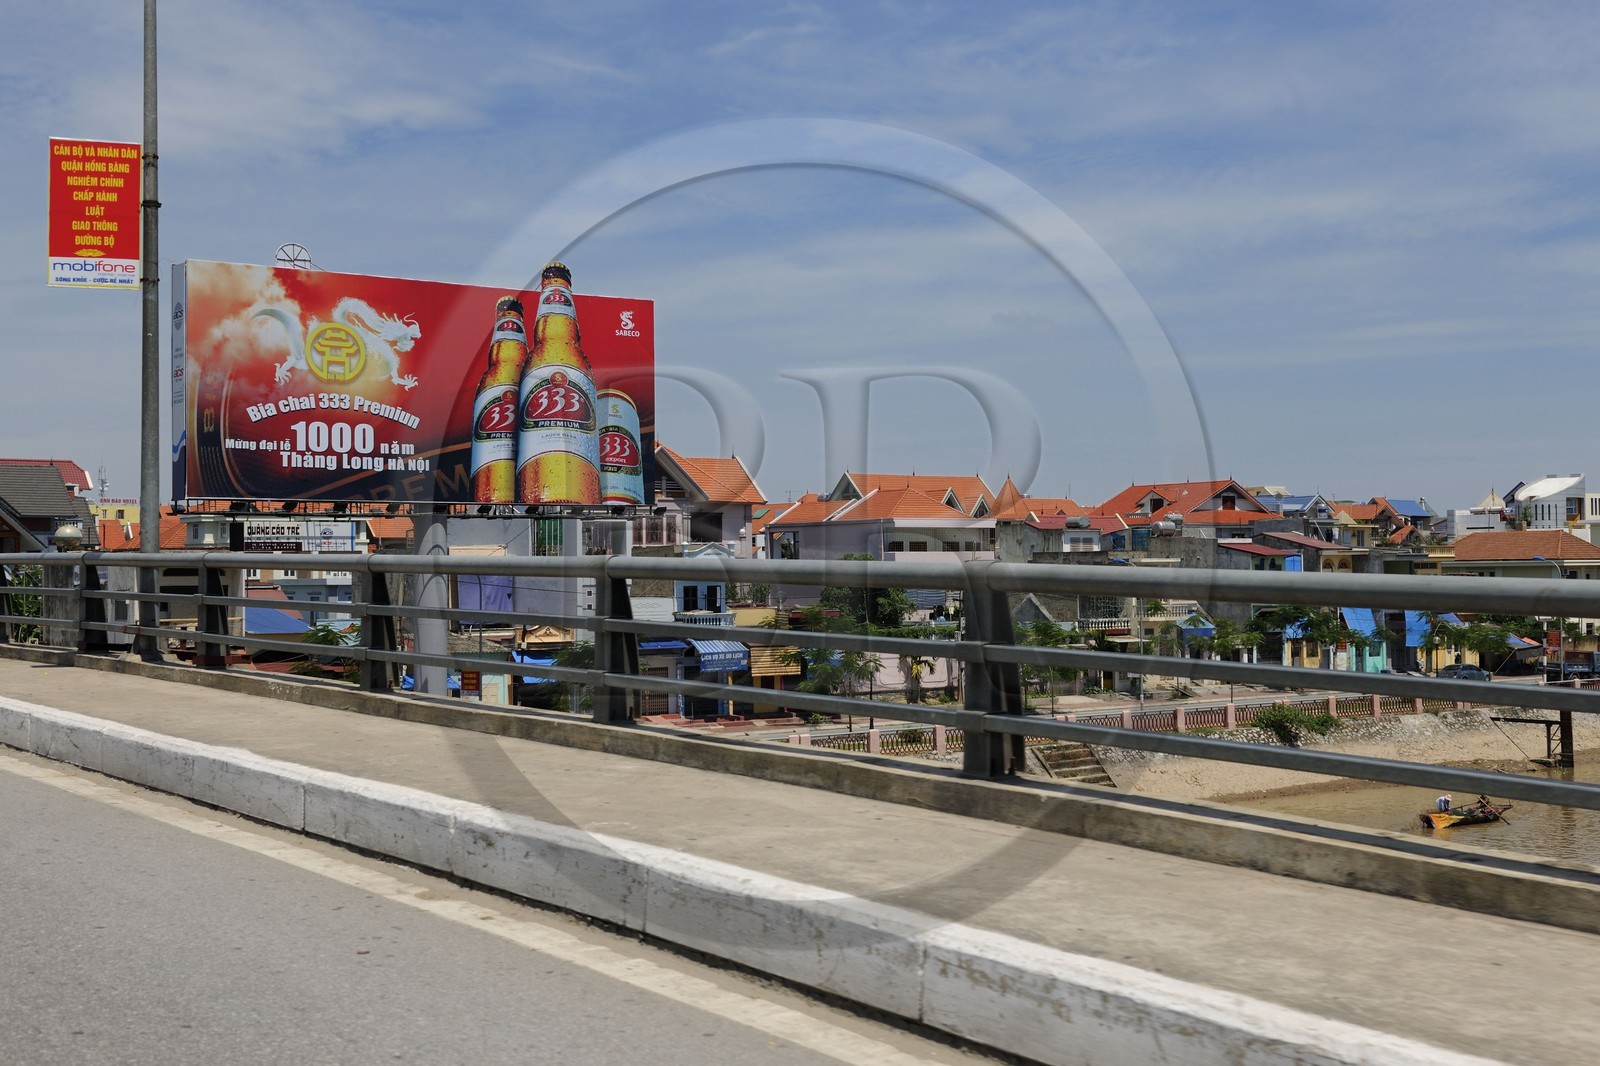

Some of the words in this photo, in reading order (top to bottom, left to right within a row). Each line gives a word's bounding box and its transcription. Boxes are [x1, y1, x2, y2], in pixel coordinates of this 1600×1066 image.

[72, 145, 83, 158] BỘ
[85, 146, 95, 157] VÀ
[97, 146, 119, 158] NHÂN
[121, 147, 137, 158] DÂN
[61, 160, 82, 173] QUẬN
[67, 175, 98, 186] NGHIÊM
[73, 189, 94, 201] CHẤP
[96, 191, 117, 202] HÀNH
[85, 205, 104, 218] LUẬT
[72, 221, 90, 230] GIAO
[92, 220, 118, 231] THÔNG
[75, 234, 102, 245] ĐƯỜNG
[104, 235, 114, 248] BỘ
[53, 260, 135, 273] mobifone
[246, 402, 278, 422] Bia
[279, 394, 316, 413] chai
[318, 393, 350, 410] 333
[533, 388, 580, 416] 333
[225, 438, 256, 450] Mừng
[259, 439, 277, 452] đại
[280, 438, 291, 451] lễ
[291, 421, 374, 454] 1000
[380, 441, 415, 455] năm
[600, 437, 630, 457] 333
[280, 452, 337, 471] Thăng
[342, 453, 384, 471] Long
[388, 457, 405, 471] HÀ
[408, 457, 430, 473] NỘI
[247, 524, 269, 536] QUẢNG
[272, 524, 284, 535] CÁO
